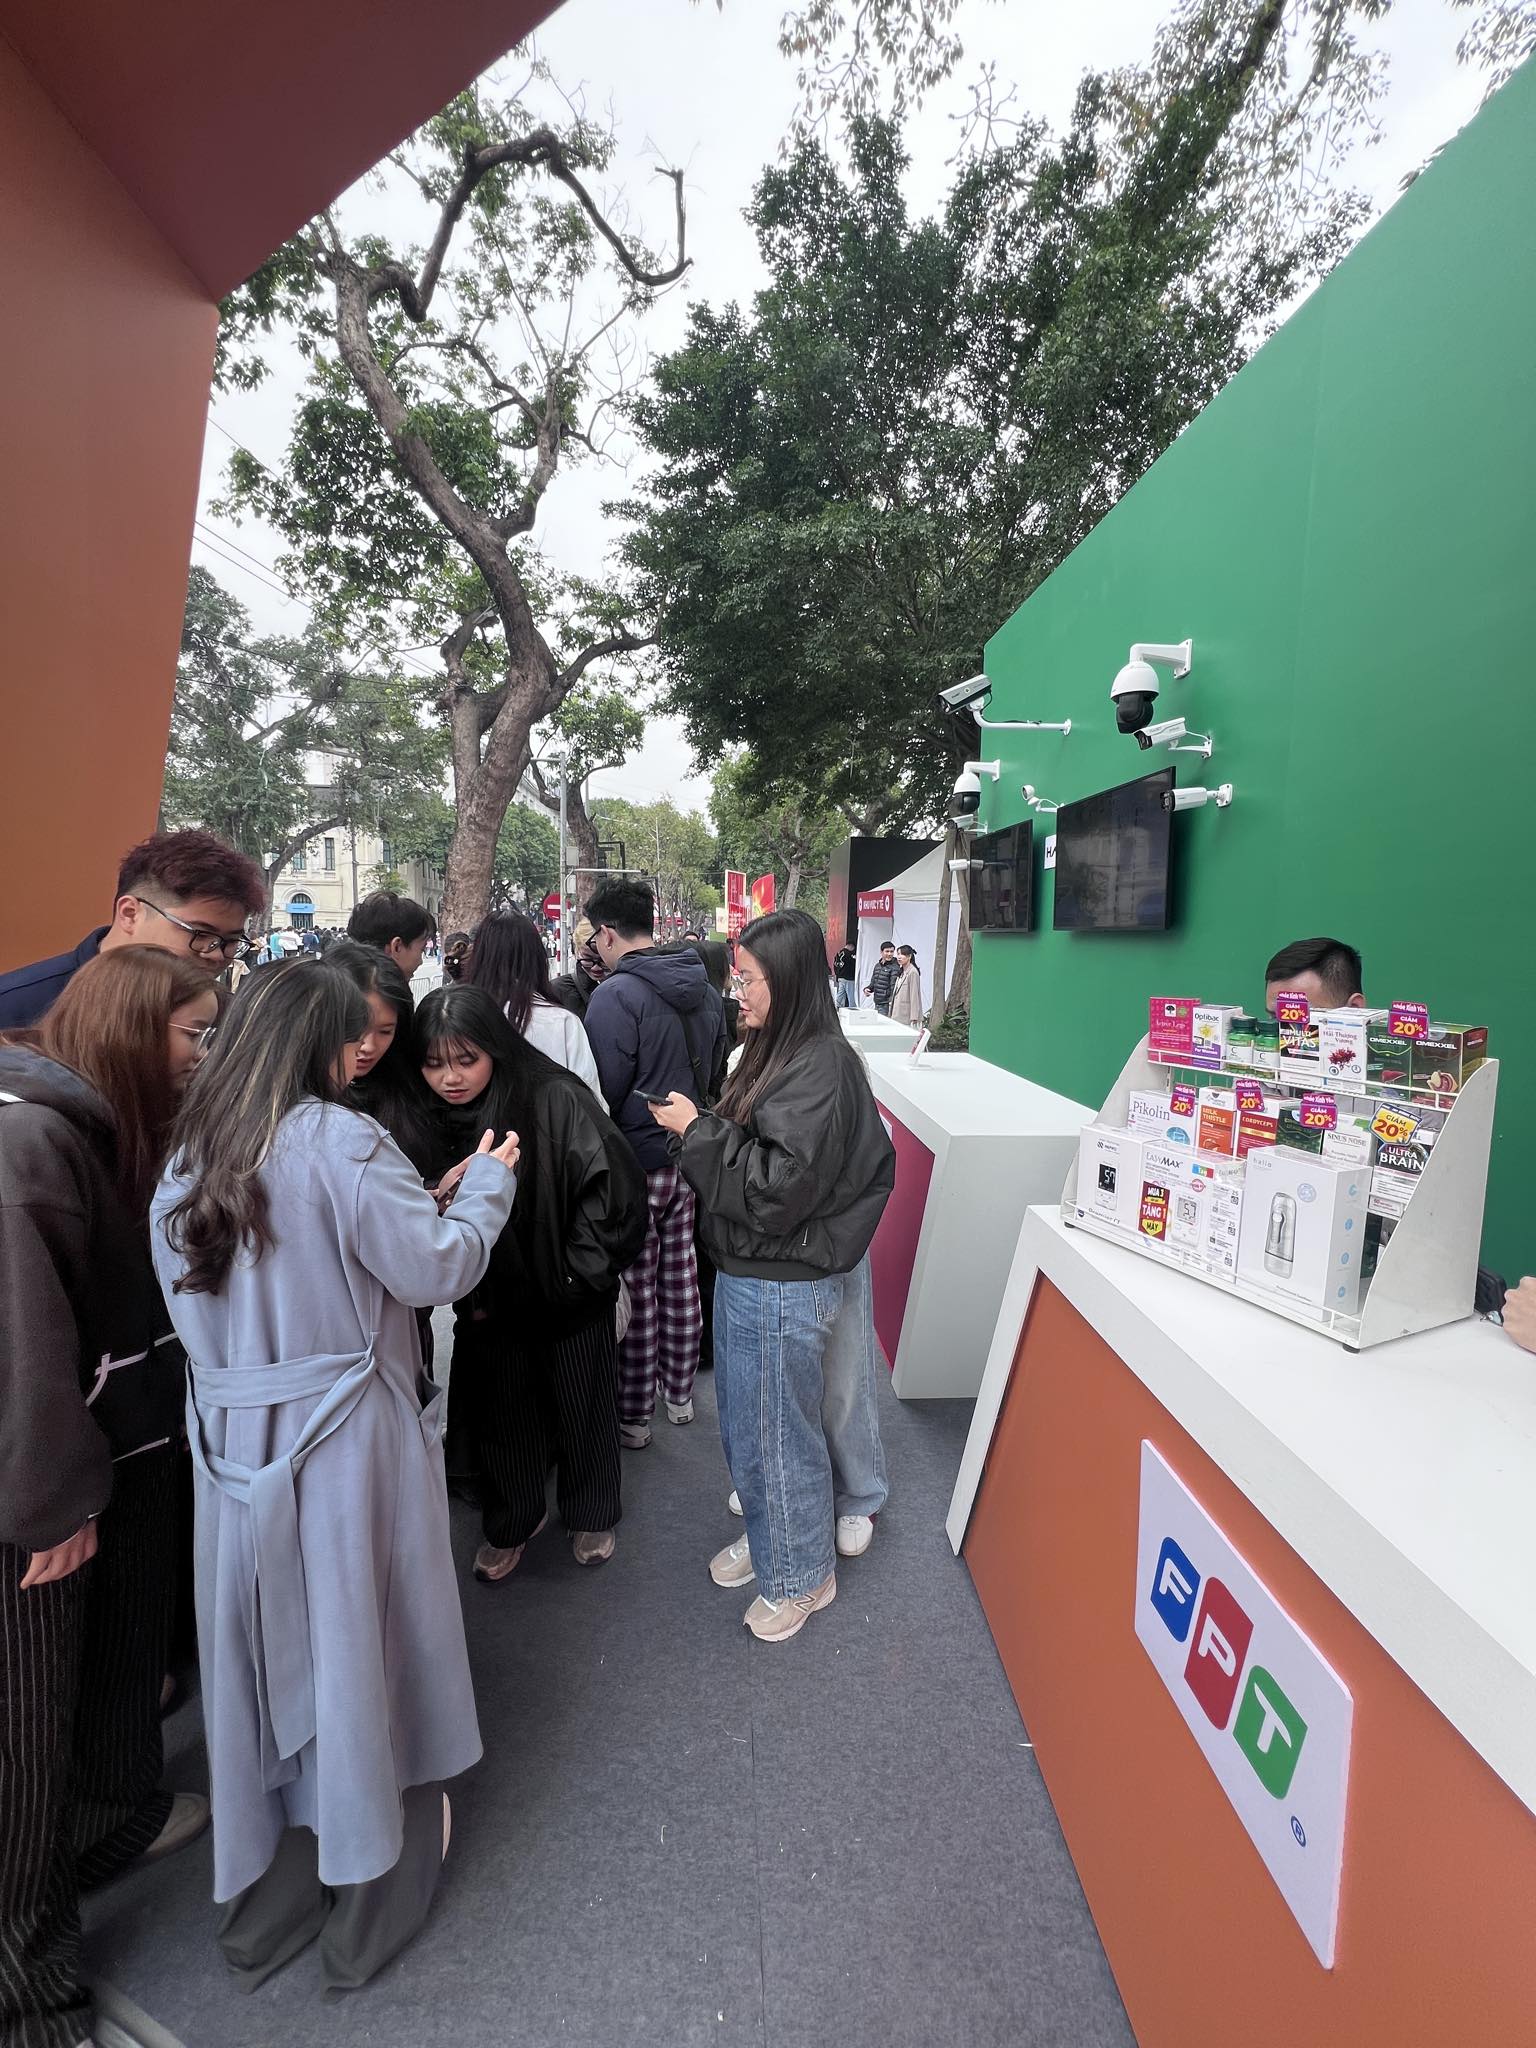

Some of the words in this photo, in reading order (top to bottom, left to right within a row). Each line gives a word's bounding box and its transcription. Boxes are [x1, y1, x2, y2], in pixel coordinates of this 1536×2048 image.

[1194, 1013, 1220, 1022] Optibac
[1280, 1009, 1305, 1020] 20%
[1393, 1022, 1423, 1035] 20%
[1283, 1035, 1316, 1048] VITAS
[1370, 1037, 1407, 1045] OMEXXEL
[1416, 1041, 1457, 1049] OMEXXEL
[1173, 1101, 1191, 1112] 20%
[1240, 1098, 1260, 1108] 20%
[1133, 1101, 1170, 1120] Pikolin
[1202, 1114, 1226, 1123] THISTLE
[1242, 1116, 1273, 1128] CORDYCEPS
[1305, 1113, 1332, 1126] 20%
[1374, 1119, 1408, 1137] 20%
[1327, 1132, 1346, 1142] SINUS
[1348, 1138, 1366, 1147] NOSE
[1388, 1146, 1418, 1159] ULTRA
[1380, 1152, 1424, 1170] BRAIN
[1147, 1186, 1159, 1197] MUA
[1160, 1189, 1164, 1197] 3
[1142, 1203, 1161, 1219] TẶNG
[1146, 1220, 1158, 1231] MÁY
[1158, 1556, 1292, 1754] FPT
